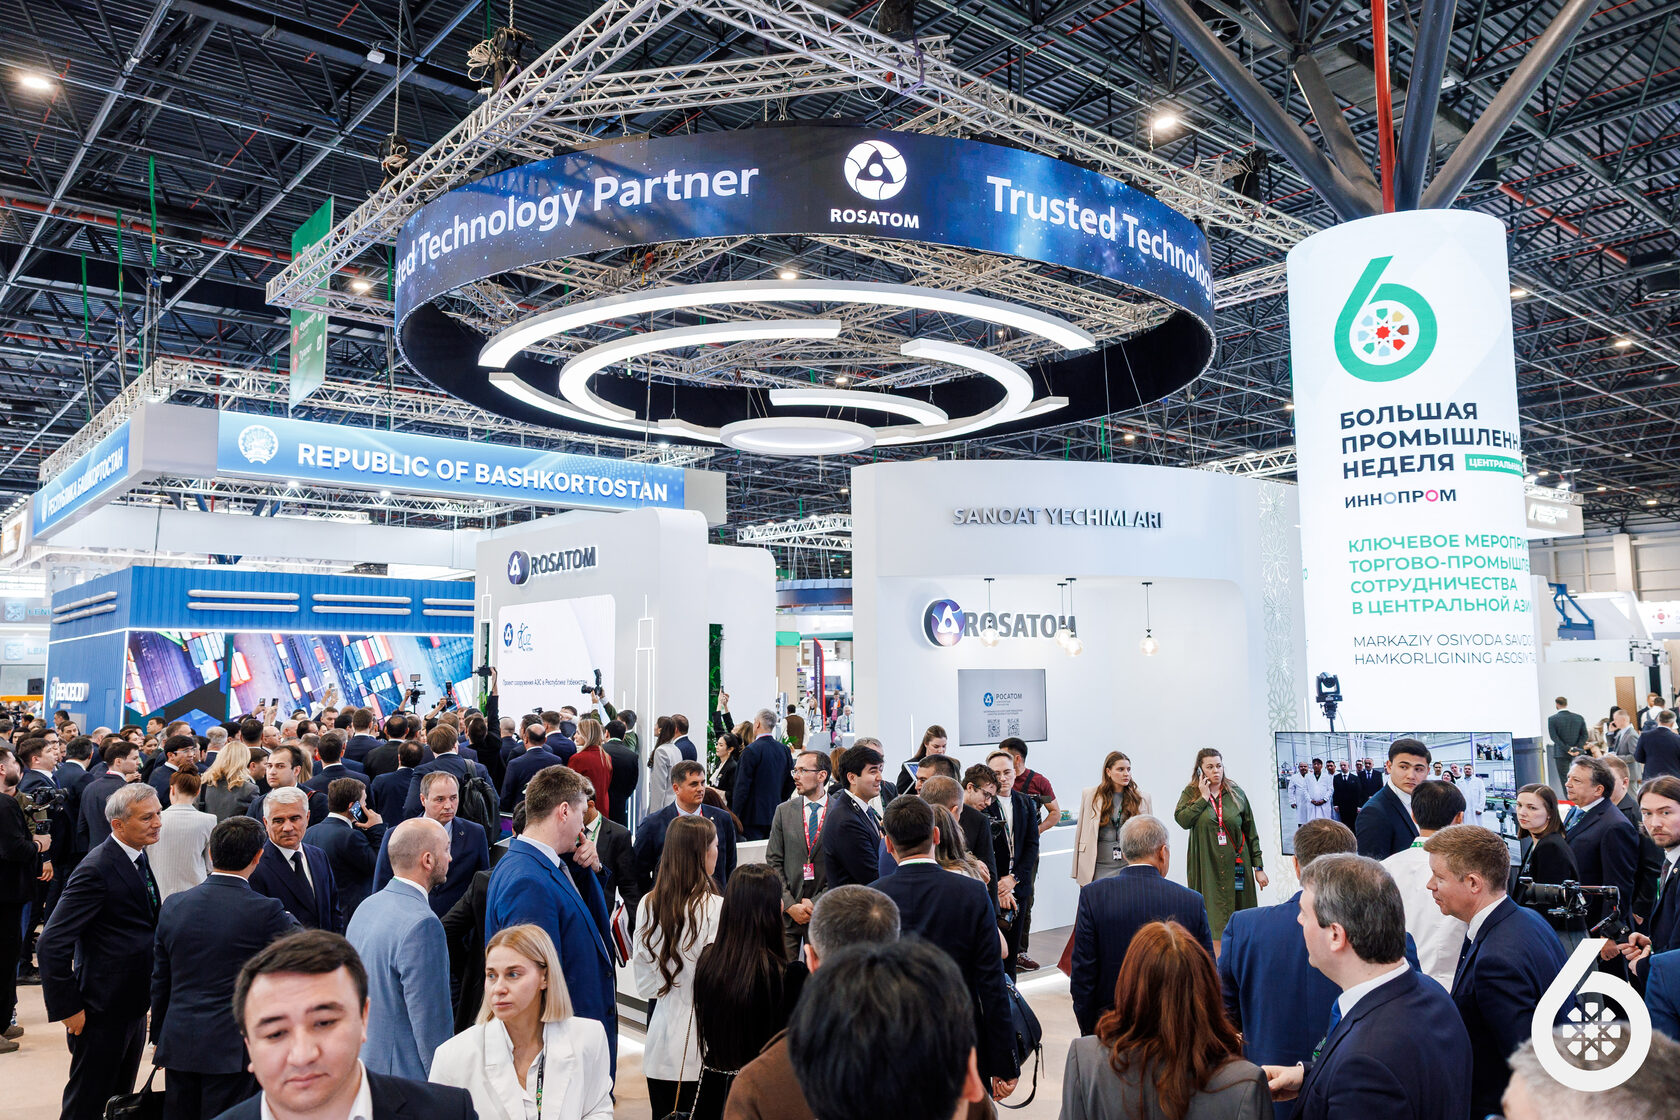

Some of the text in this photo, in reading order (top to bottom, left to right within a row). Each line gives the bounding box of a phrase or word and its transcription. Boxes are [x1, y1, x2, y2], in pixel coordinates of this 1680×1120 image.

[418, 189, 583, 266] Technology
[593, 168, 759, 212] Partner
[830, 208, 920, 229] ROSATOM
[986, 175, 1213, 303] Trusted Technolog
[1340, 402, 1478, 430] БОЛЬШАЯ
[298, 443, 668, 502] REPUBLIC OF BASHKORTOSTAN
[1343, 453, 1455, 479] НЕДЕЛЯ
[1345, 489, 1457, 509] ИННОПРОМ
[952, 507, 1163, 529] SANOAT YECHIMLARI
[1348, 534, 1460, 553] КЛЮЧЕВОЕ
[530, 546, 596, 576] ROSATOM
[1350, 577, 1518, 594] СОТРУДНИЧЕСТВА
[1352, 601, 1364, 614] В
[1368, 595, 1511, 616] ЦЕНТРАЛЬНОЙ
[963, 612, 1078, 639] ROSATOM
[1353, 634, 1433, 648] MARKAZIY
[1436, 633, 1502, 646] OSIYODA
[1354, 652, 1492, 665] HAMKORLIGINING
